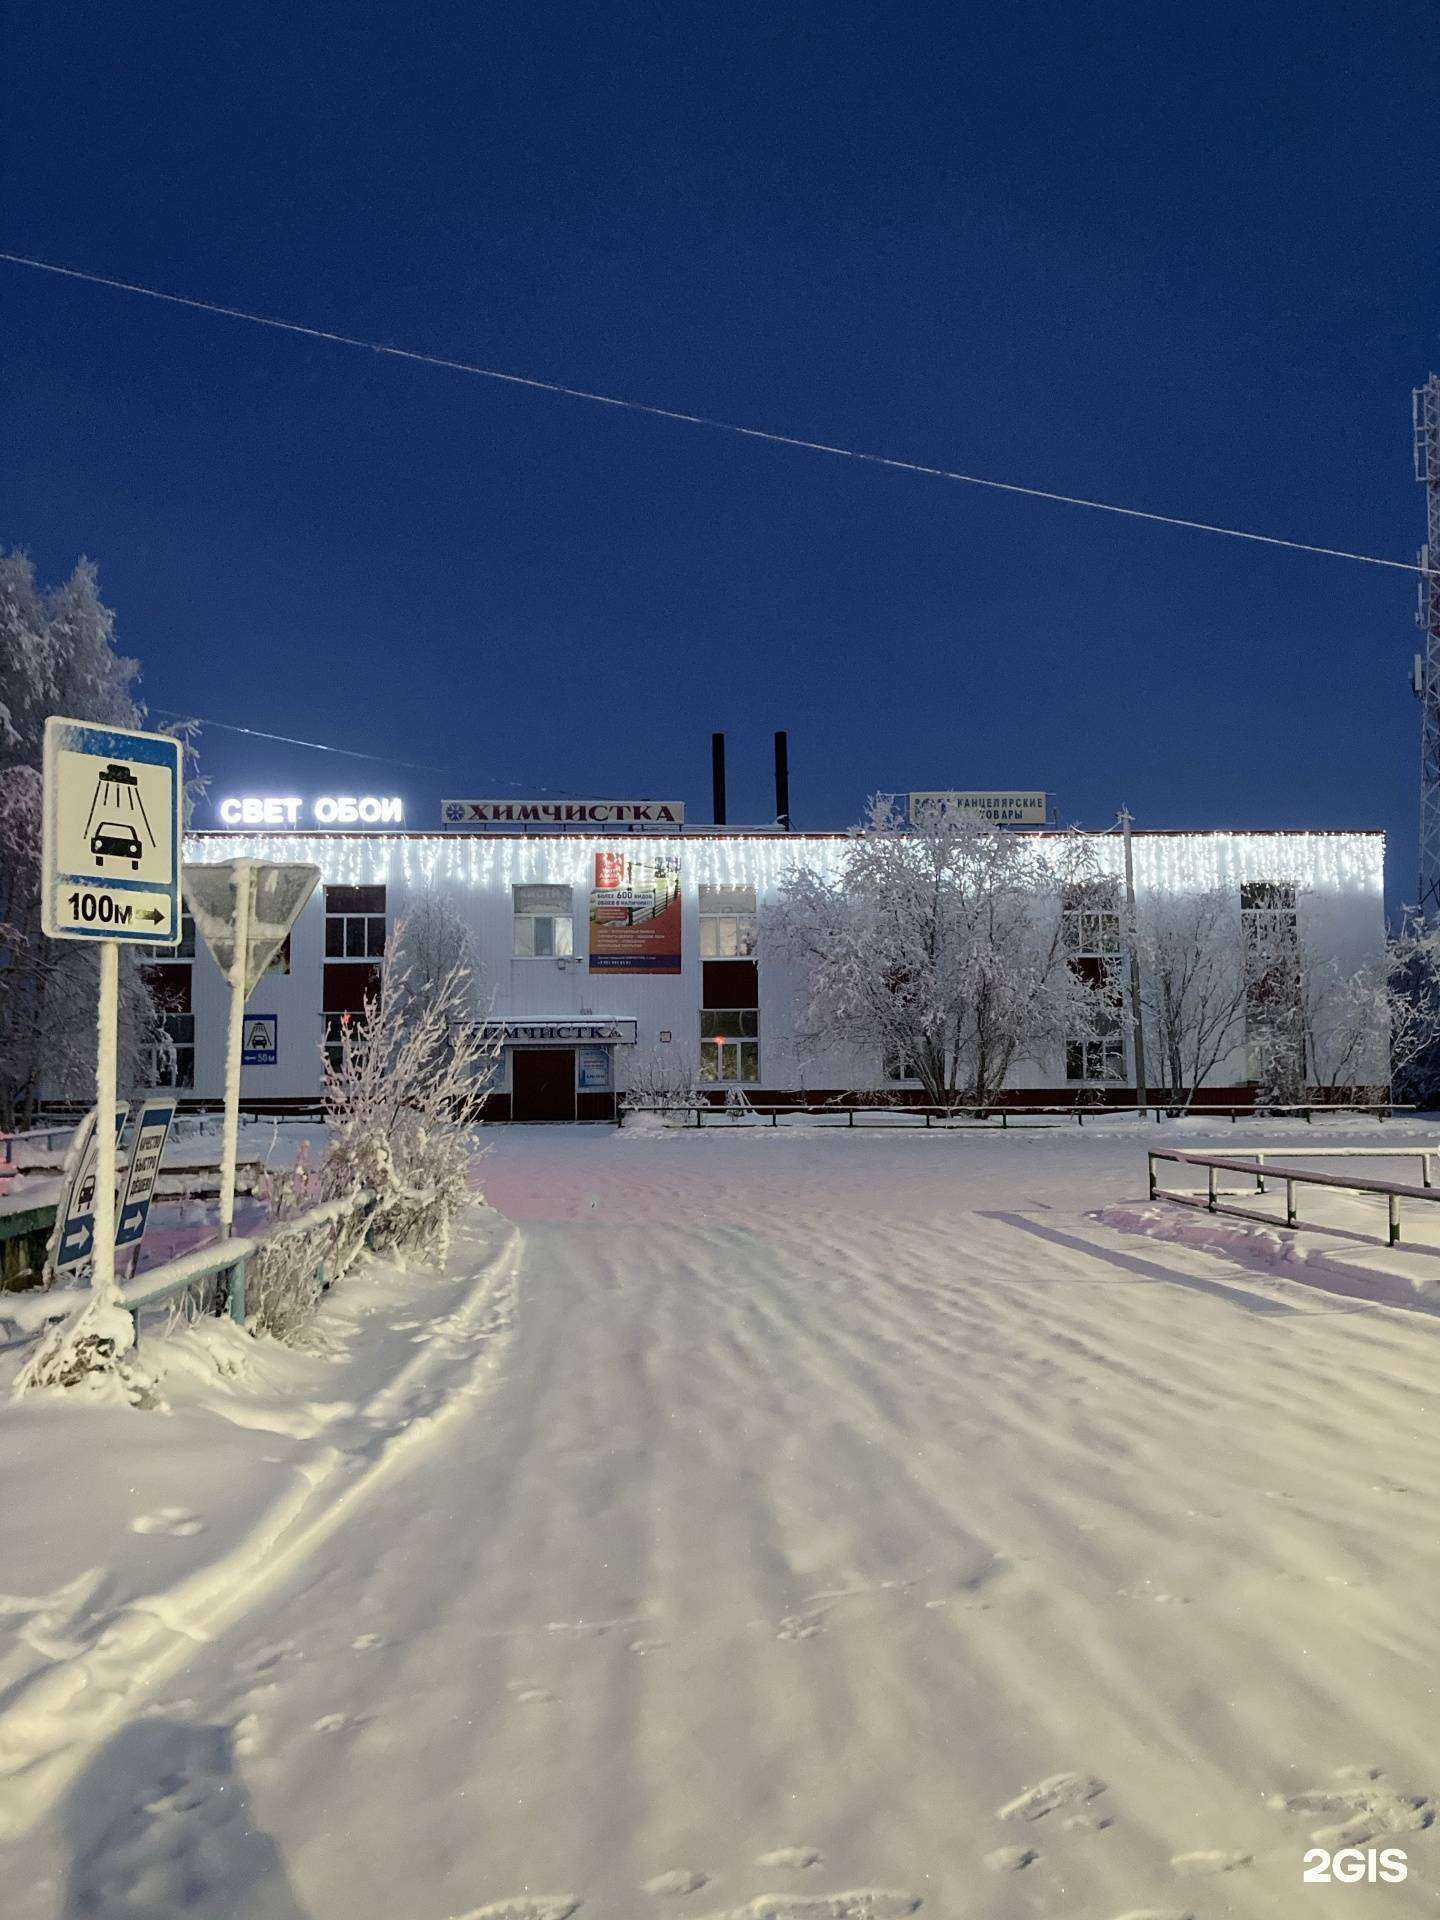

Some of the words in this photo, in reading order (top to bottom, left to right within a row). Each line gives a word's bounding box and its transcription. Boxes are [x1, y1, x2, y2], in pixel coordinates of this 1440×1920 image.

[220, 797, 302, 823] СВЕТ
[314, 797, 402, 823] ОБОИ
[957, 798, 1043, 808] КАНЦЕЛЯРСКИЕ
[468, 804, 676, 822] ХИМЧИСТКА
[616, 891, 633, 899] 600
